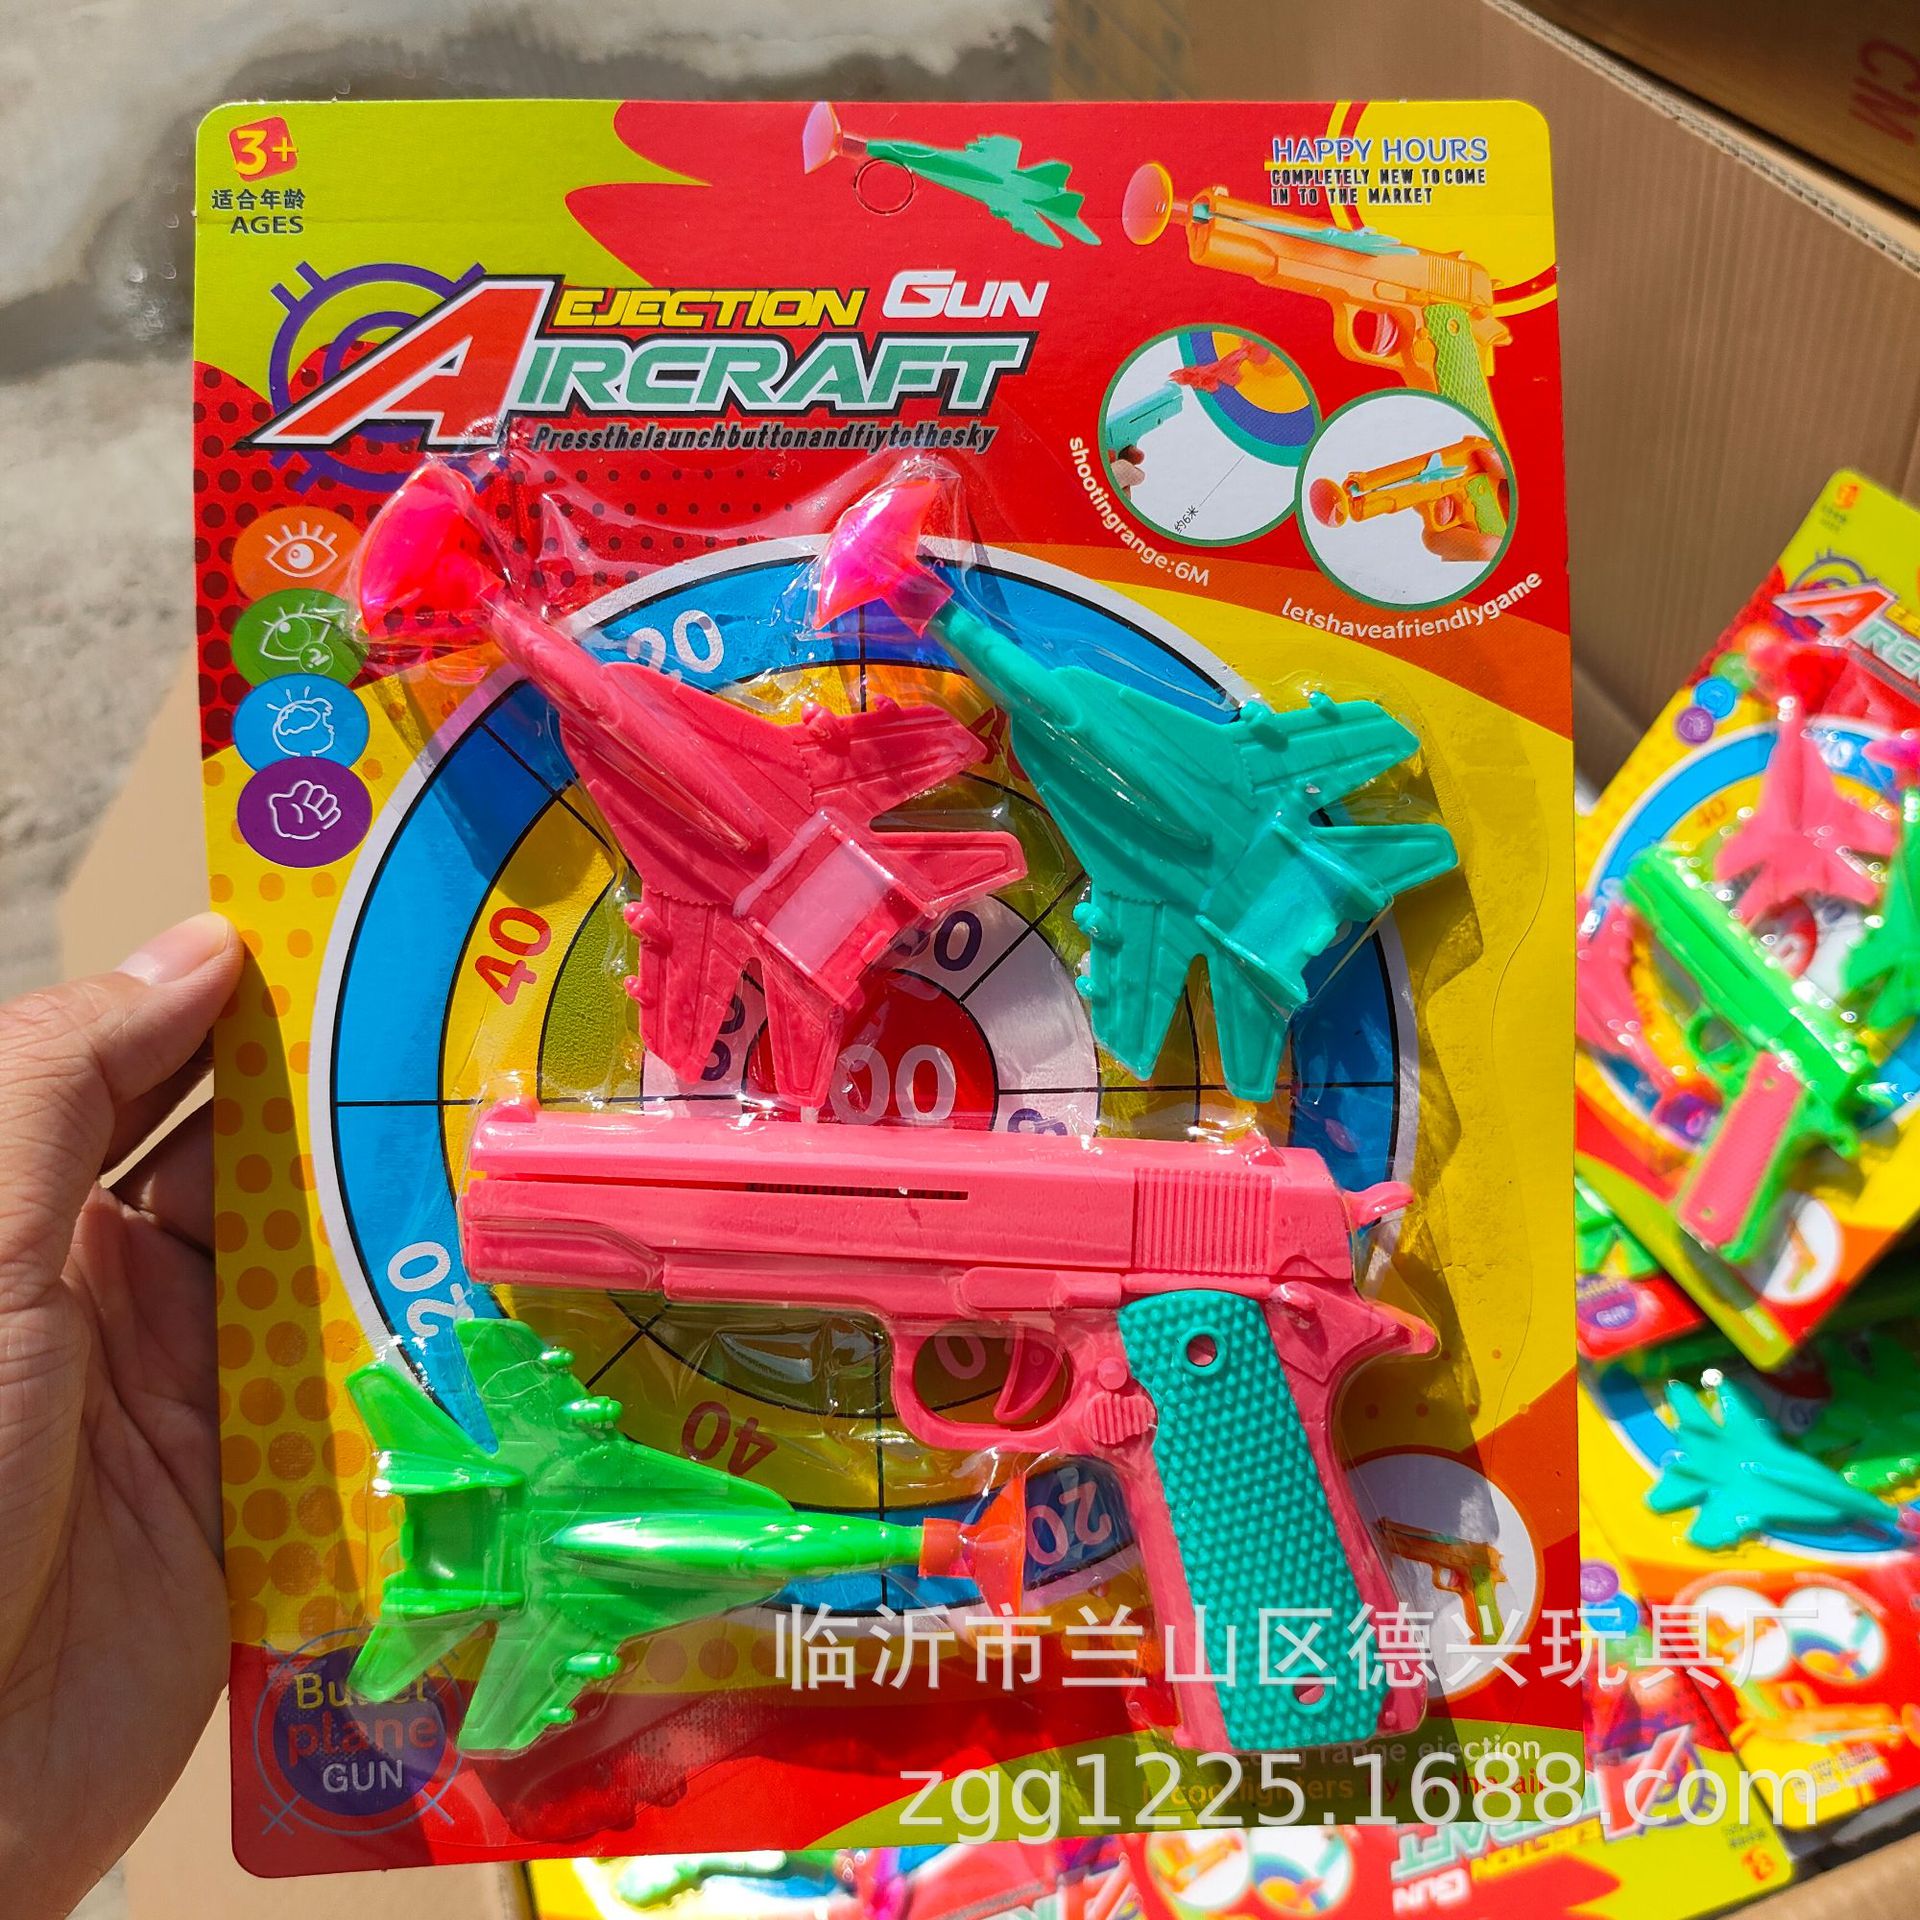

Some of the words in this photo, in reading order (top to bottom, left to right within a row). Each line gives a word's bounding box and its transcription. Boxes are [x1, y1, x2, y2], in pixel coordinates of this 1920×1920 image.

[233, 128, 297, 176] 3+
[1271, 168, 1370, 185] COMPLETELY
[1379, 168, 1414, 185] NEW
[1272, 138, 1372, 162] HAPPY
[1382, 138, 1488, 162] HOURS
[211, 188, 306, 211] 适合年龄
[1271, 187, 1289, 205] IN
[1299, 187, 1318, 205] TO
[1328, 187, 1358, 204] THE
[1367, 187, 1432, 204] MARKET
[230, 215, 305, 235] AGES
[553, 287, 868, 329] EJECTION
[882, 269, 1050, 318] GUN
[240, 275, 1038, 448] AIRCRAFT
[1069, 436, 1210, 587] shootingrange:6M
[1174, 504, 1199, 535] 约6米
[474, 906, 552, 1006] 40
[387, 1240, 476, 1338] 20
[680, 1400, 778, 1477] 40
[1026, 1480, 1112, 1565] 20
[286, 1709, 438, 1767] plane
[322, 1758, 404, 1793] GUN
